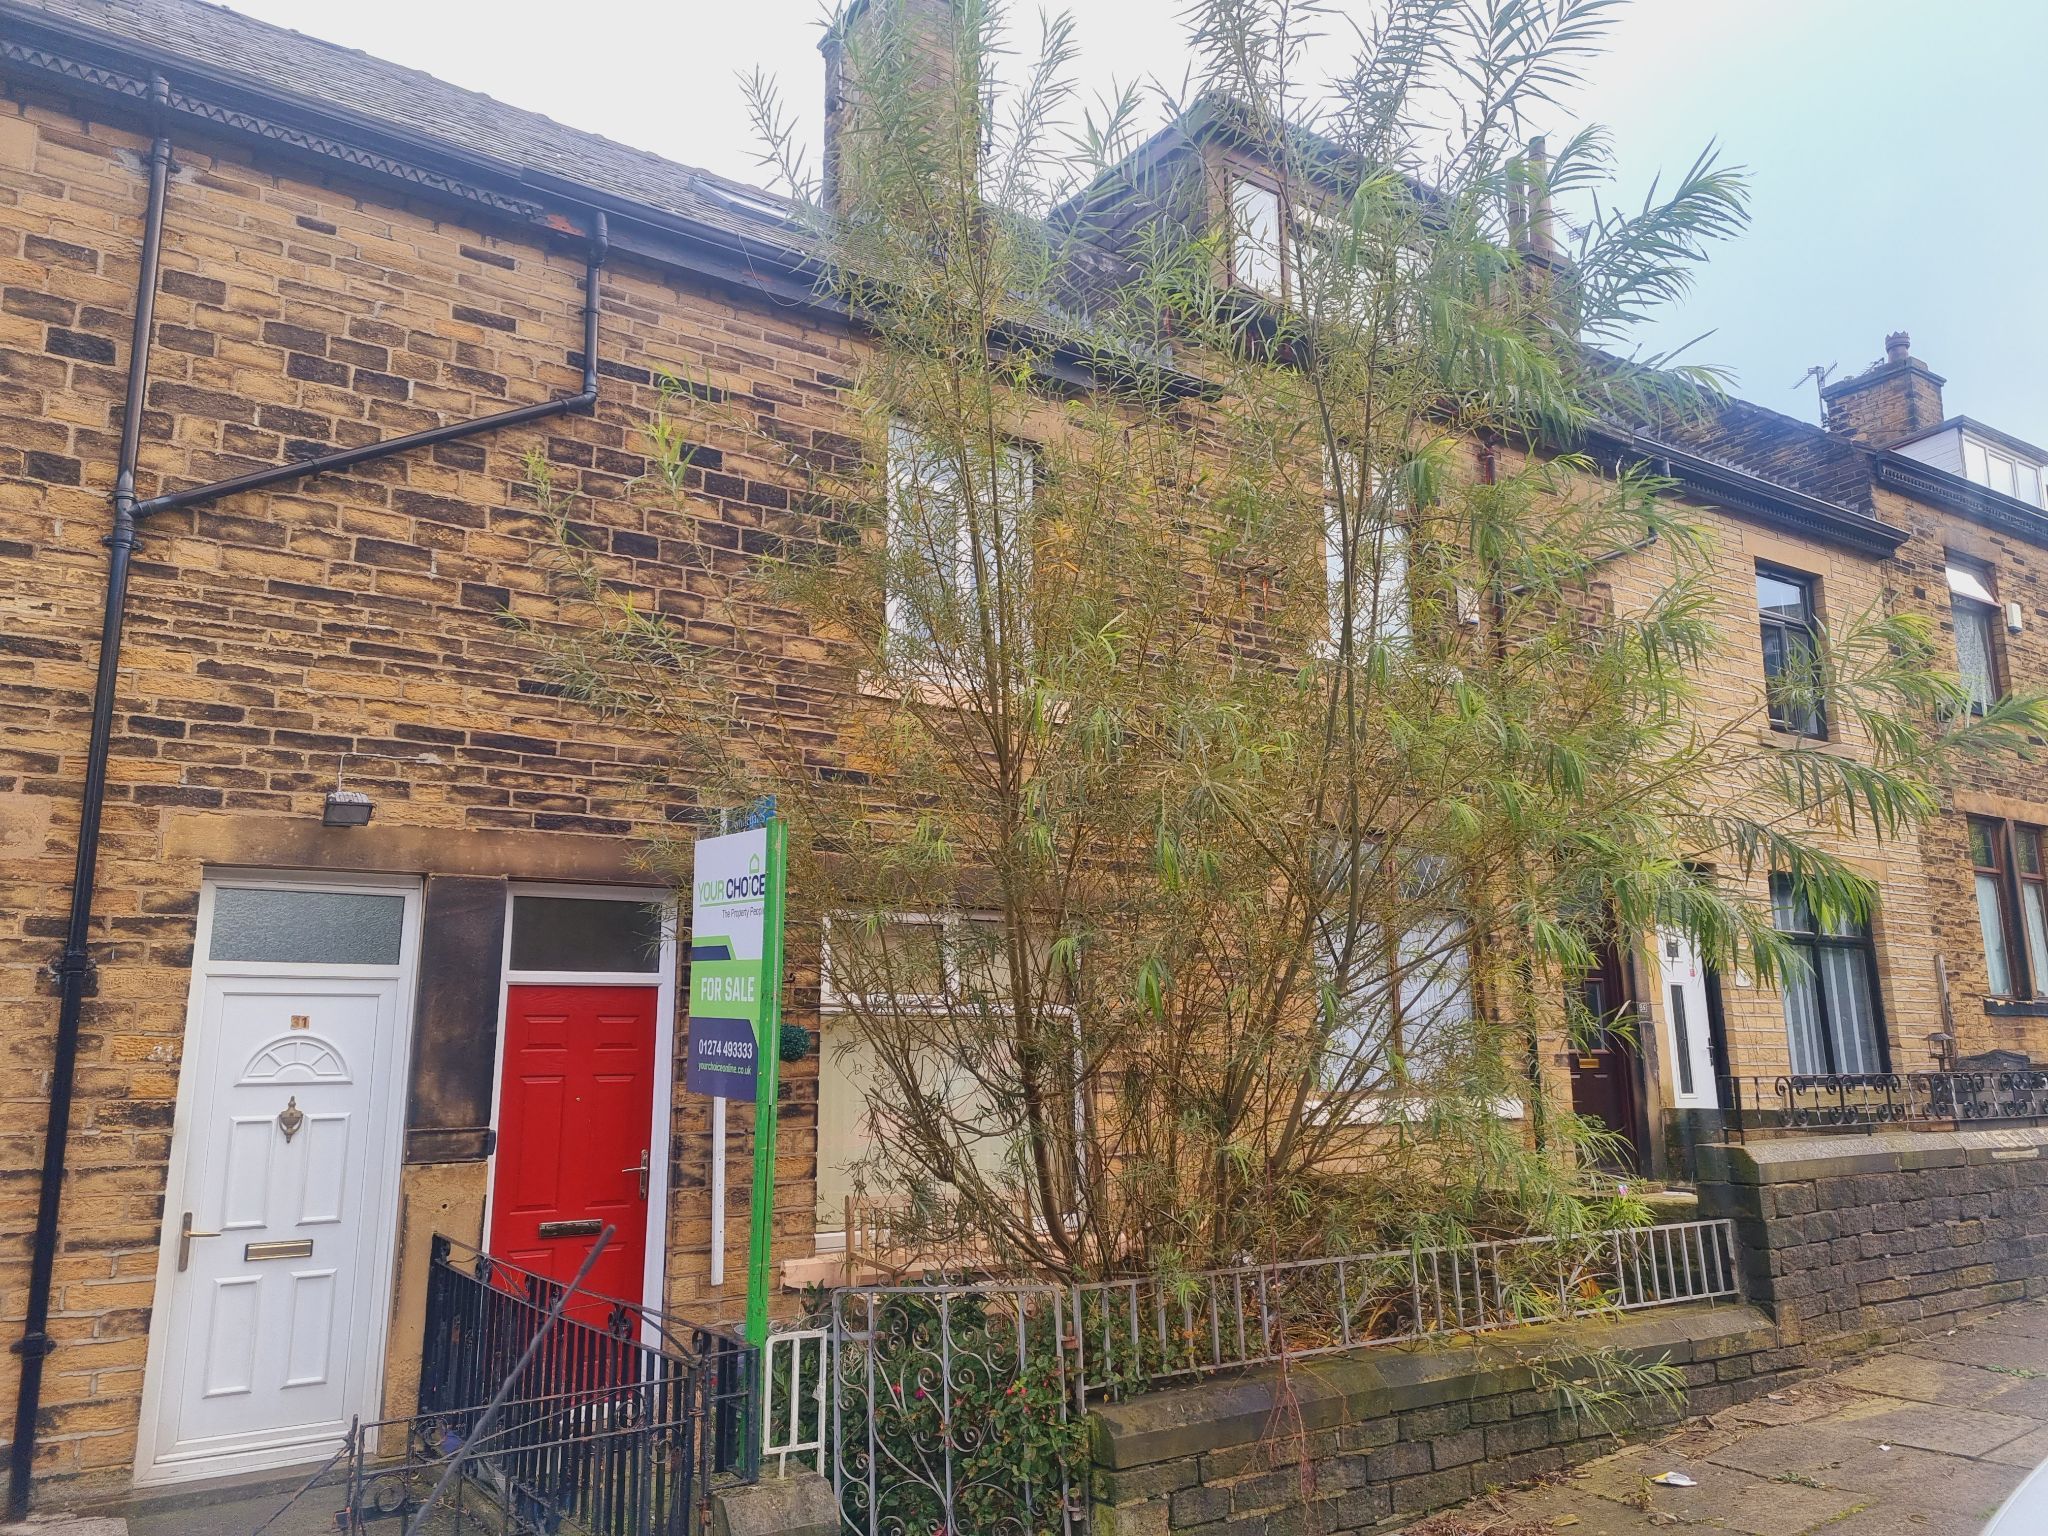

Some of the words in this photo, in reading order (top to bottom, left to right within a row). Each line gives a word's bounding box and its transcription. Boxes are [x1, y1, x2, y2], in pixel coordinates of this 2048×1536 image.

[698, 880, 725, 901] YOUR
[726, 874, 765, 899] CHOICE
[722, 909, 731, 918] The
[731, 908, 750, 918] Property
[701, 977, 722, 1001] FOR
[725, 976, 755, 1001] SALE
[698, 1039, 722, 1056] 01274
[722, 1041, 753, 1059] 493333
[698, 1061, 752, 1075] yourchoiceonline.co.uk
